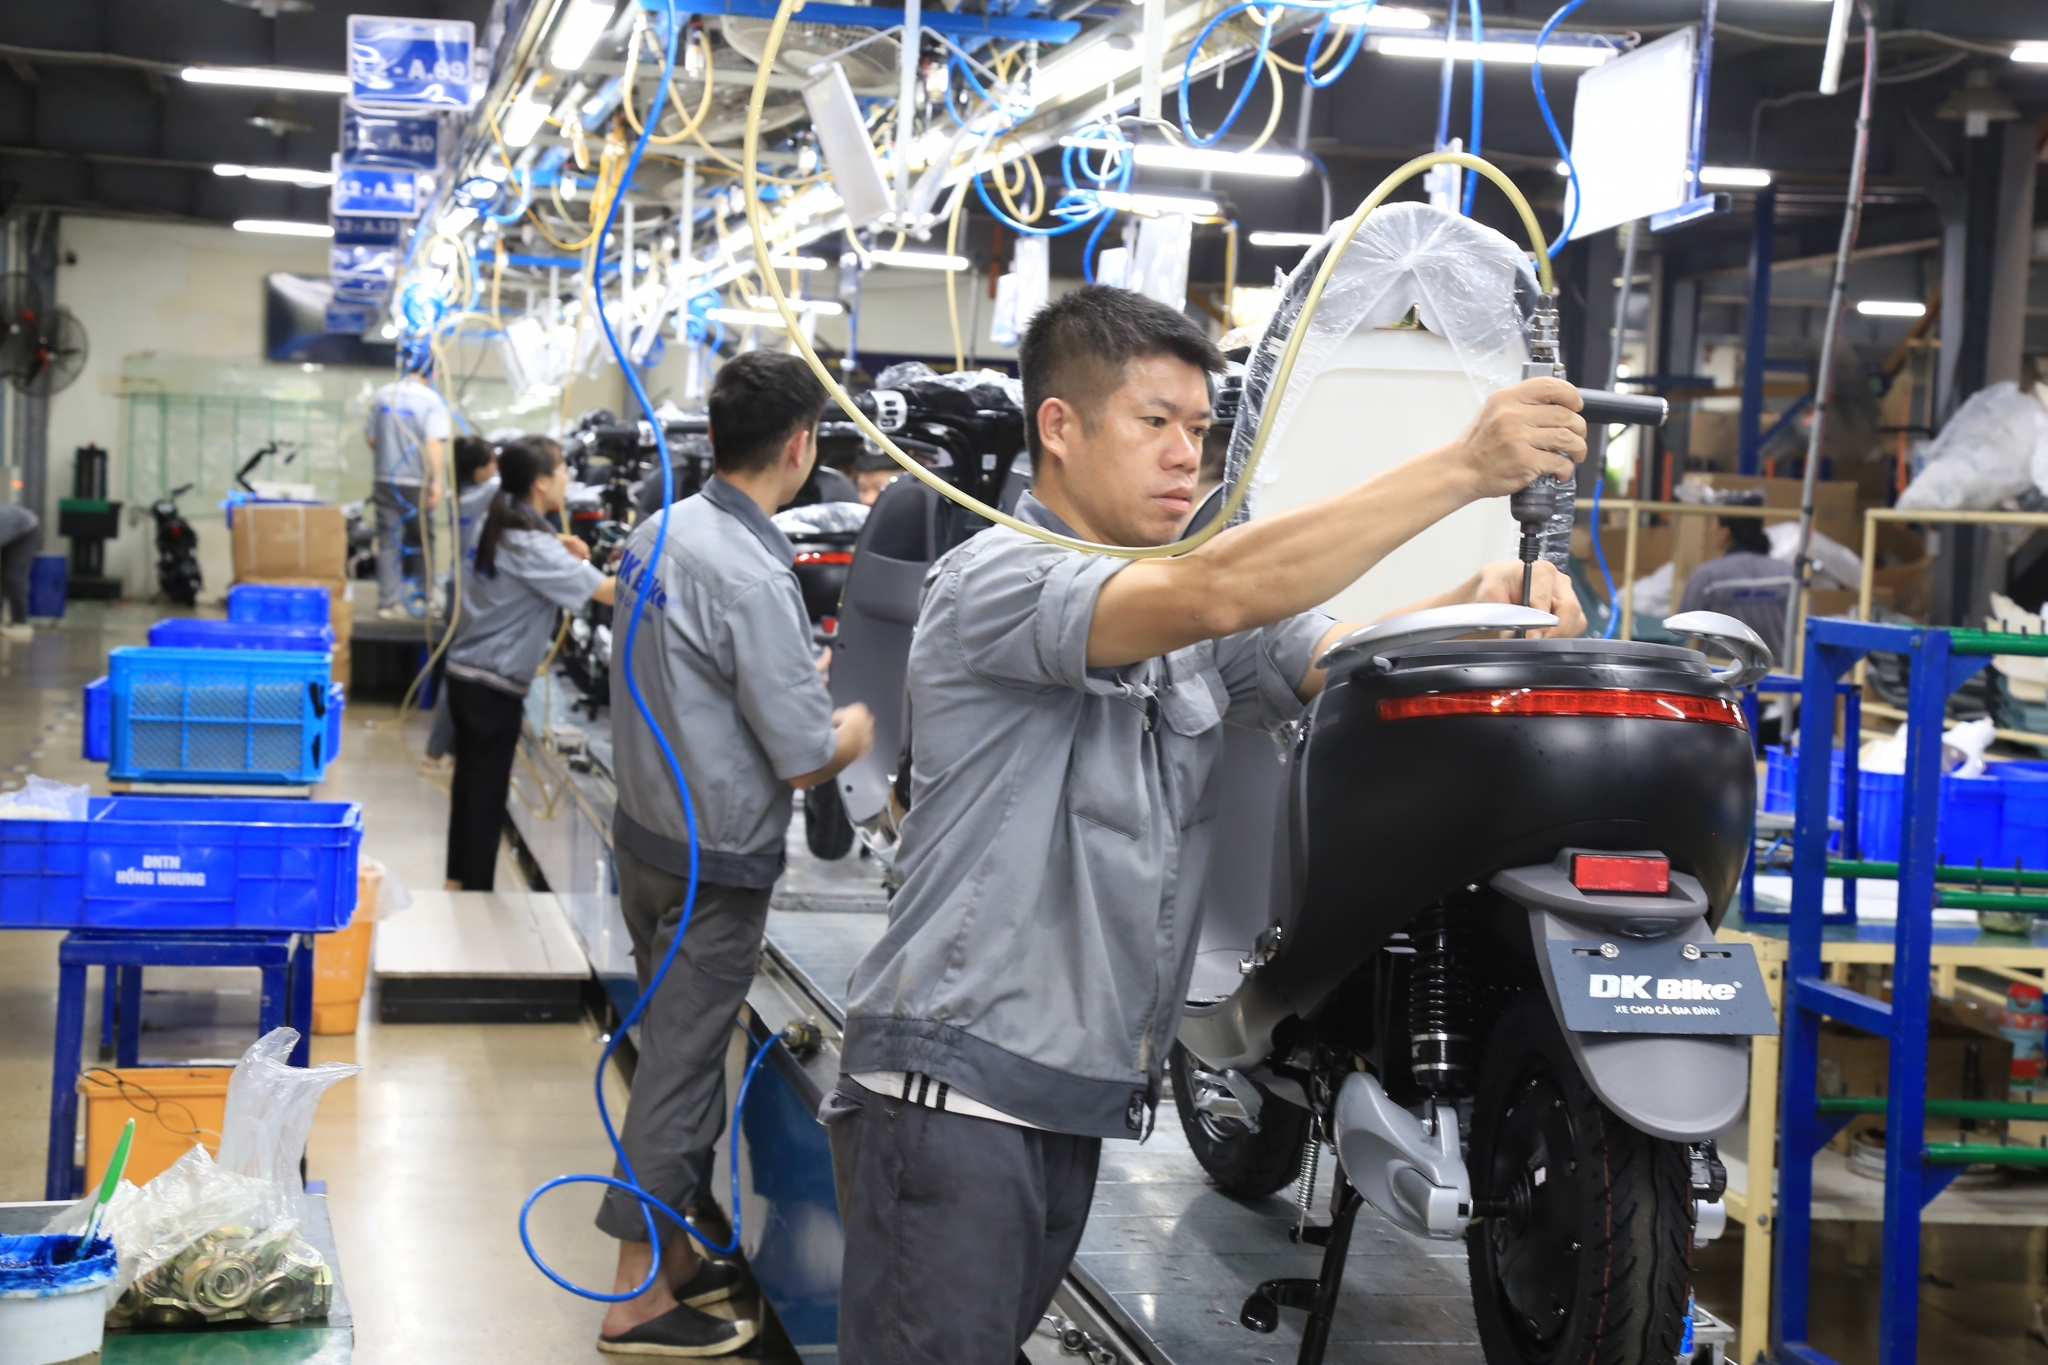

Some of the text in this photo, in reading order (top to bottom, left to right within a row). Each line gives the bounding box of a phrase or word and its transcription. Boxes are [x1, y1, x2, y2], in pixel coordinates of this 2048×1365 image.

[157, 871, 206, 887] NHUNG
[1589, 974, 1653, 999] DK
[1613, 1004, 1629, 1014] XE
[1629, 1005, 1655, 1015] CHO
[1672, 1006, 1693, 1016] GIA
[1692, 1004, 1721, 1016] ĐÌNH
